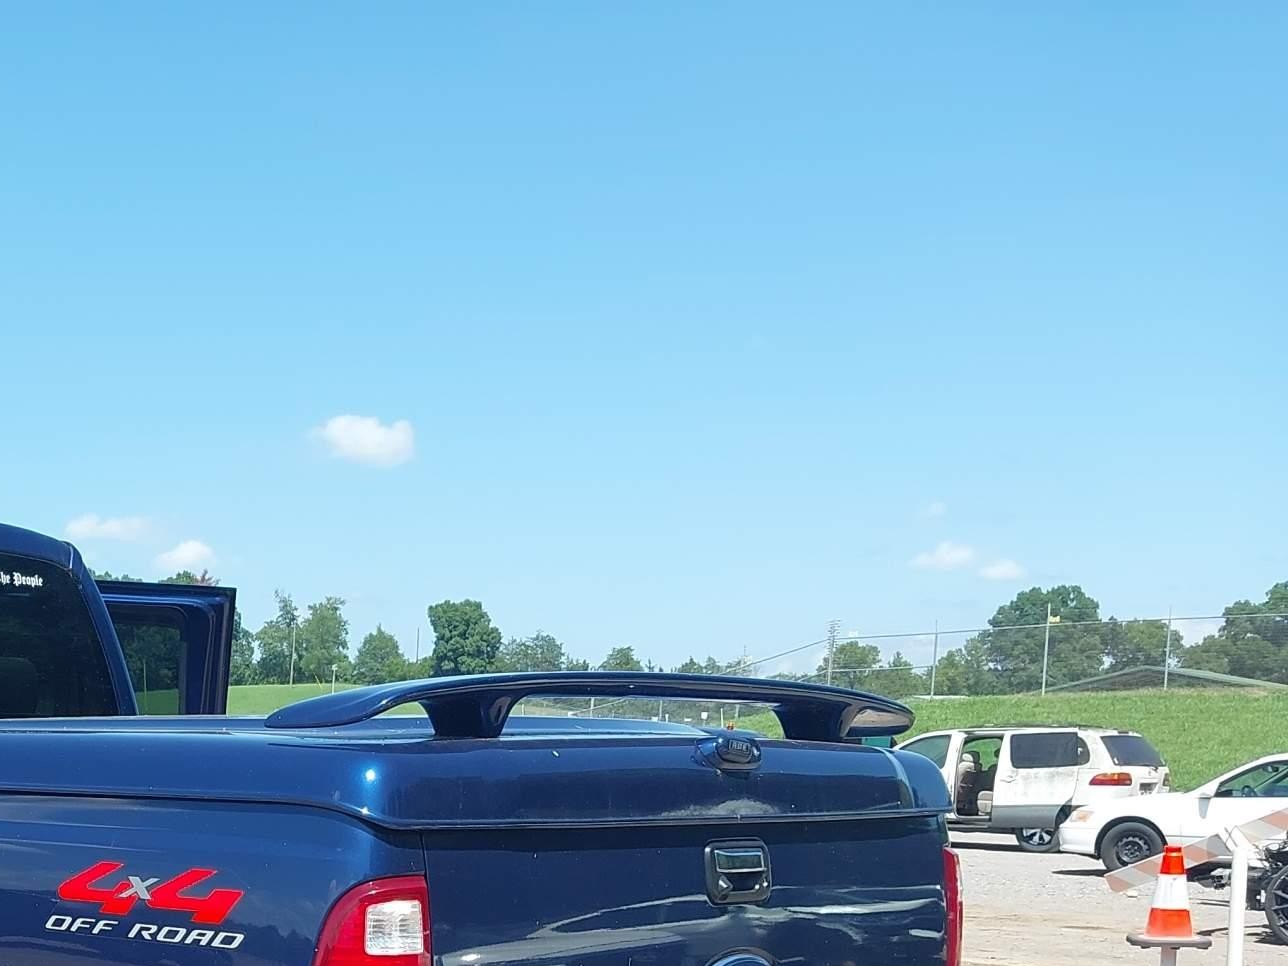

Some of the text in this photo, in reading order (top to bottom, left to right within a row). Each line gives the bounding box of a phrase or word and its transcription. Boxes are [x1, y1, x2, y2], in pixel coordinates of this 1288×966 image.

[13, 572, 44, 588] People
[45, 914, 245, 950] OFF ROAD
